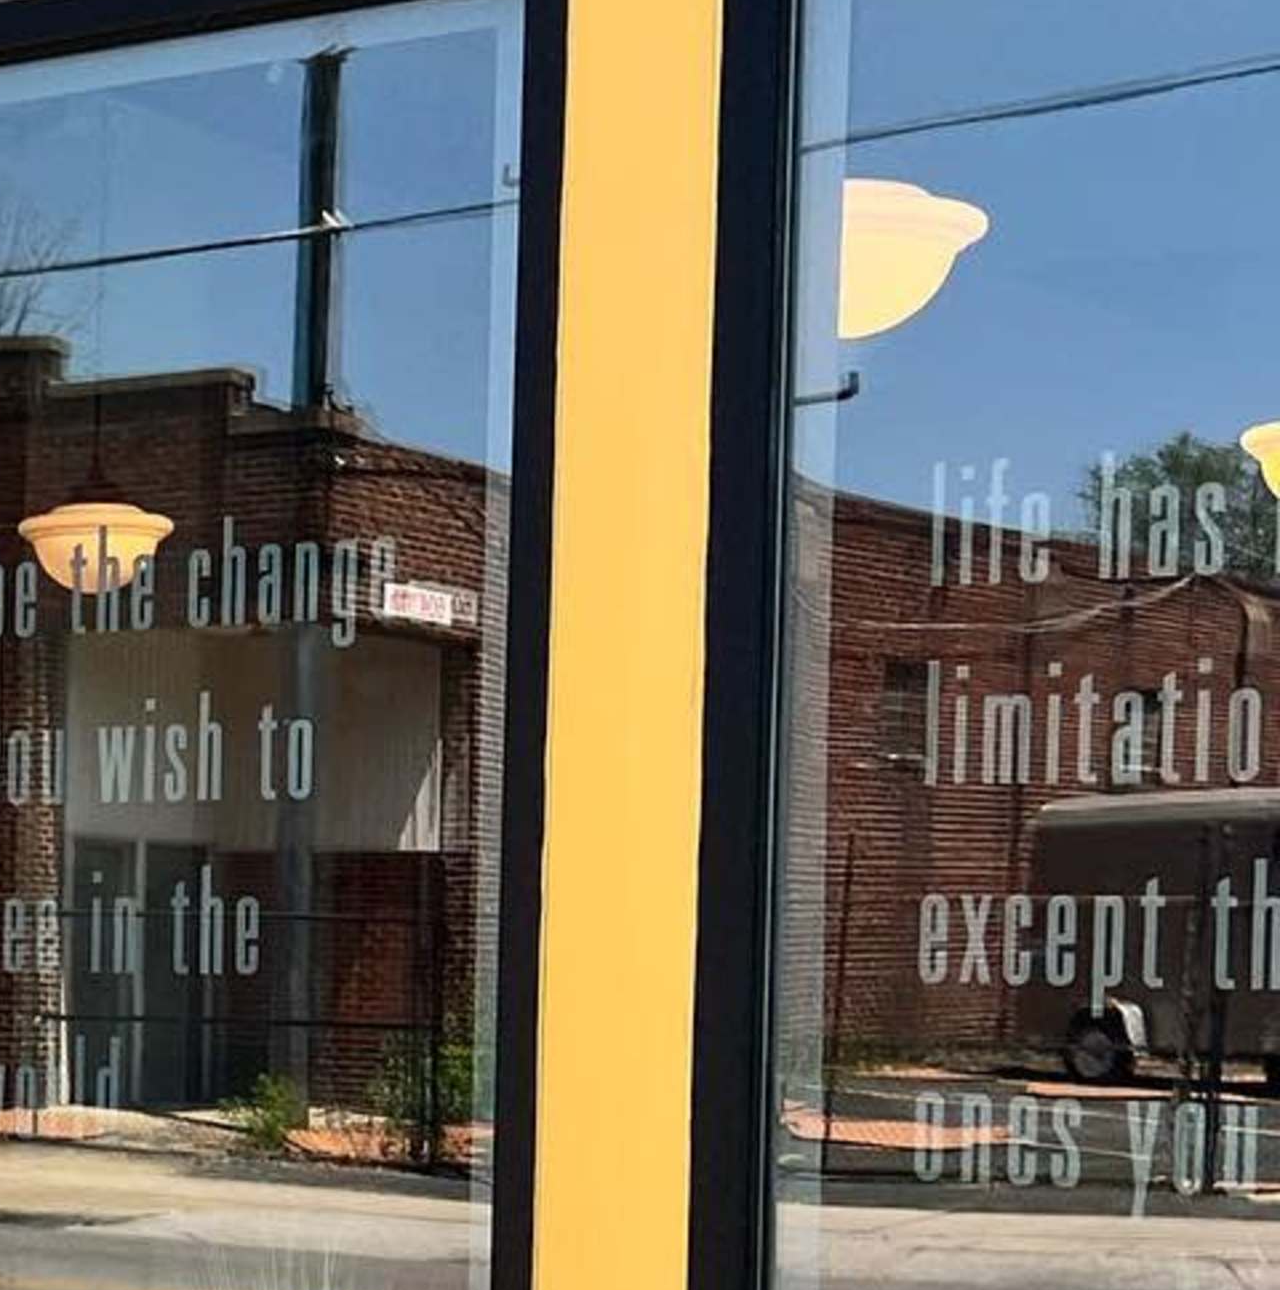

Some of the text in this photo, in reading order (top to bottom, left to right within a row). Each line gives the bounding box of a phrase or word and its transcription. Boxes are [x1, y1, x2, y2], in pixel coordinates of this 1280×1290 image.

[70, 524, 156, 635] the
[187, 515, 398, 648] change
[929, 449, 1228, 587] life has
[97, 690, 224, 804] wish
[258, 704, 314, 801] to
[922, 657, 1262, 786] limitatio
[91, 870, 137, 974] in
[170, 863, 260, 975] the
[918, 877, 1167, 1018] except
[914, 1091, 1082, 1189] ones
